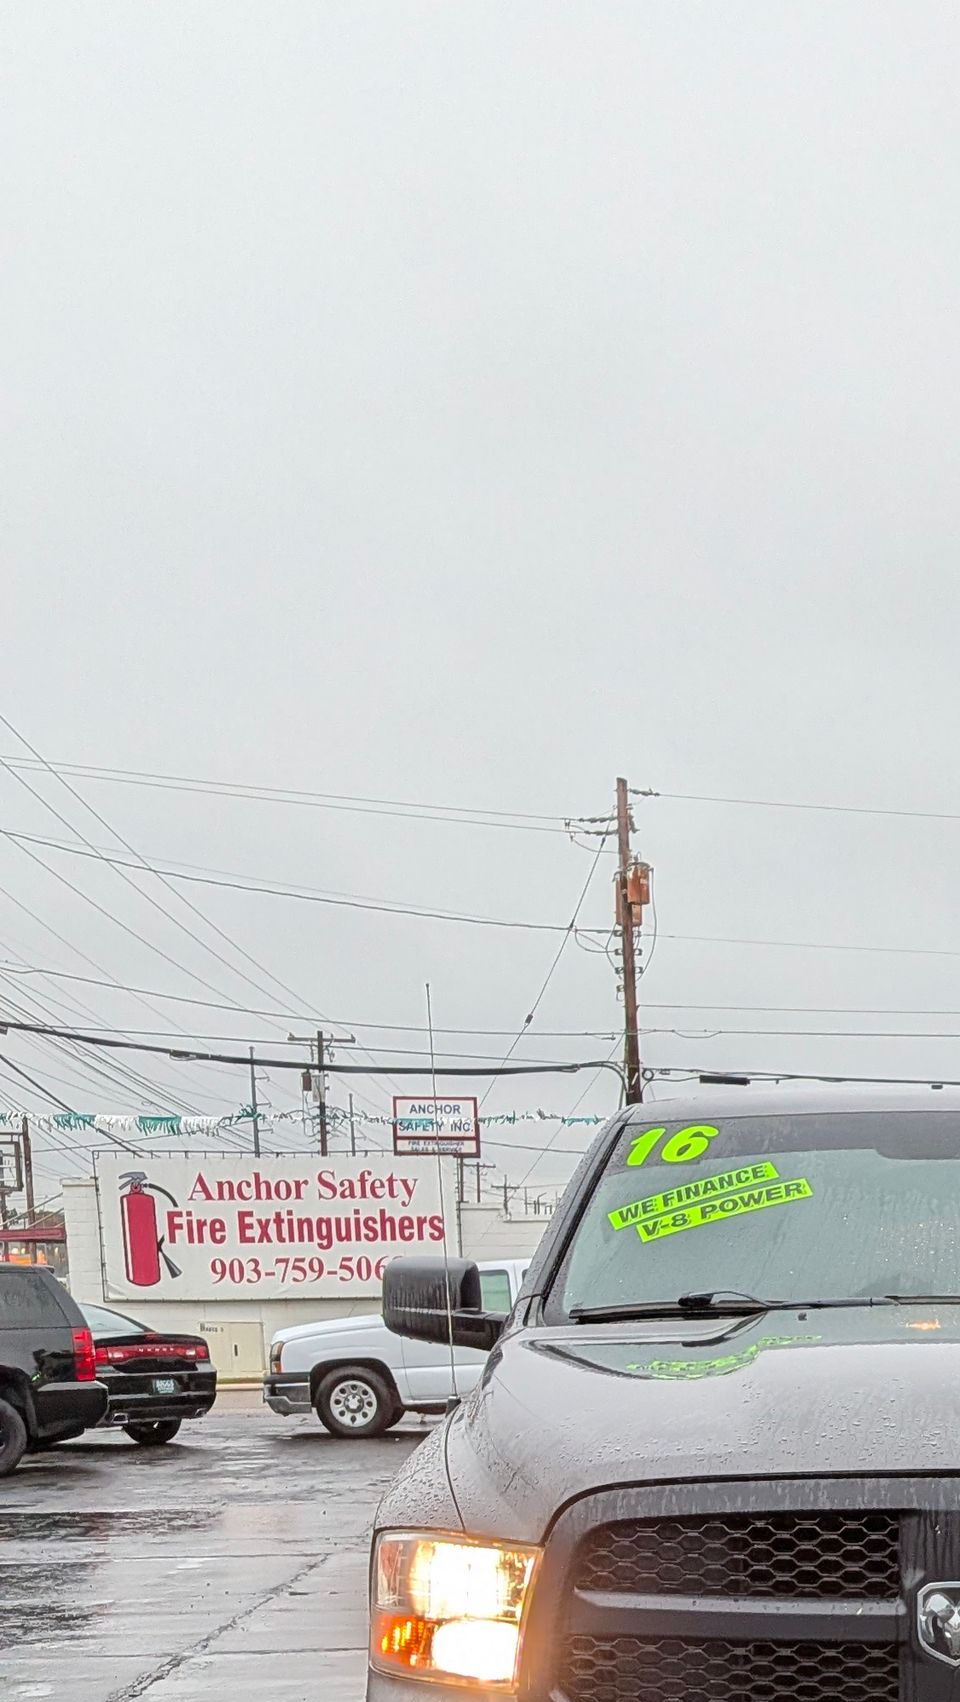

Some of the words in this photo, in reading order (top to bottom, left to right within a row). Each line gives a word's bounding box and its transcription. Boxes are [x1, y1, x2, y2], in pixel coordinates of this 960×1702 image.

[398, 1121, 444, 1132] SAFETY
[409, 1104, 461, 1114] ANCHOR
[626, 1125, 720, 1167] 16
[187, 1171, 309, 1201] Anchor
[317, 1170, 419, 1207] Safety
[617, 1203, 656, 1224] WE
[662, 1165, 768, 1207] FINANCE
[166, 1210, 227, 1244] Fire
[237, 1208, 445, 1250] Extinguishers
[642, 1213, 690, 1237] V-8
[700, 1182, 806, 1220] POWER
[210, 1255, 403, 1285] 903-759-506
